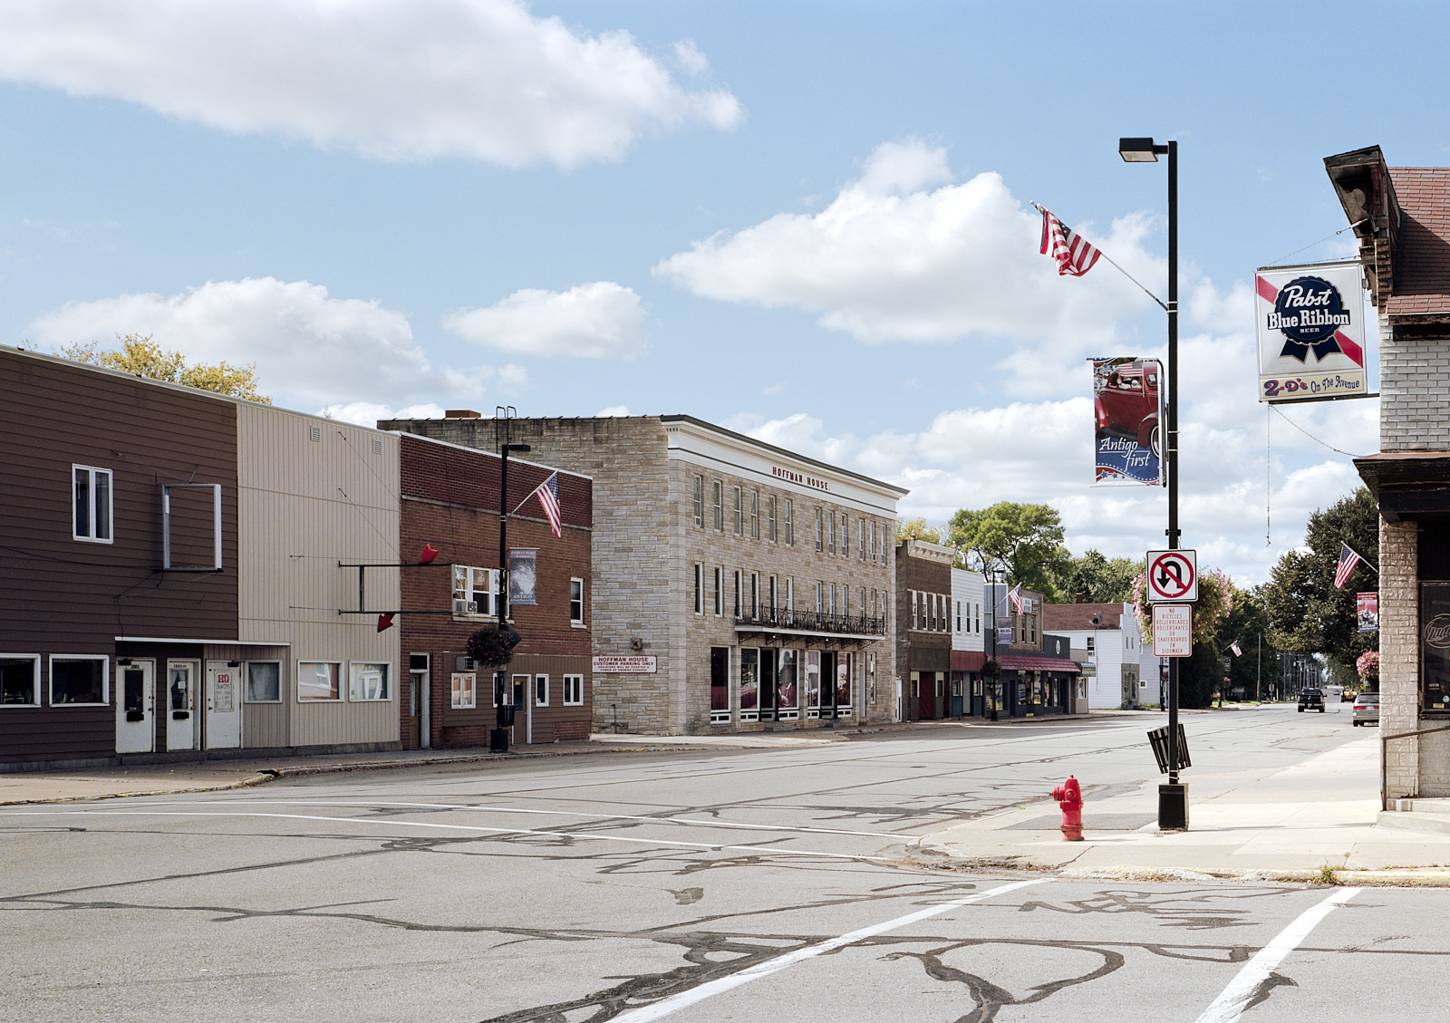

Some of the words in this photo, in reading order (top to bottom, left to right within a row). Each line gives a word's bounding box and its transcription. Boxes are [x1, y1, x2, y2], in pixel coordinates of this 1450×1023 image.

[1284, 285, 1332, 308] Pabst
[1268, 312, 1298, 330] Blue
[1299, 309, 1350, 327] Ribbon
[1311, 381, 1321, 393] On
[1321, 377, 1334, 391] The
[1335, 375, 1360, 389] Avenue
[1099, 436, 1138, 458] Antigo
[1123, 450, 1152, 473] first
[772, 466, 803, 483] HOFFMAN
[807, 477, 828, 490] HOUSE
